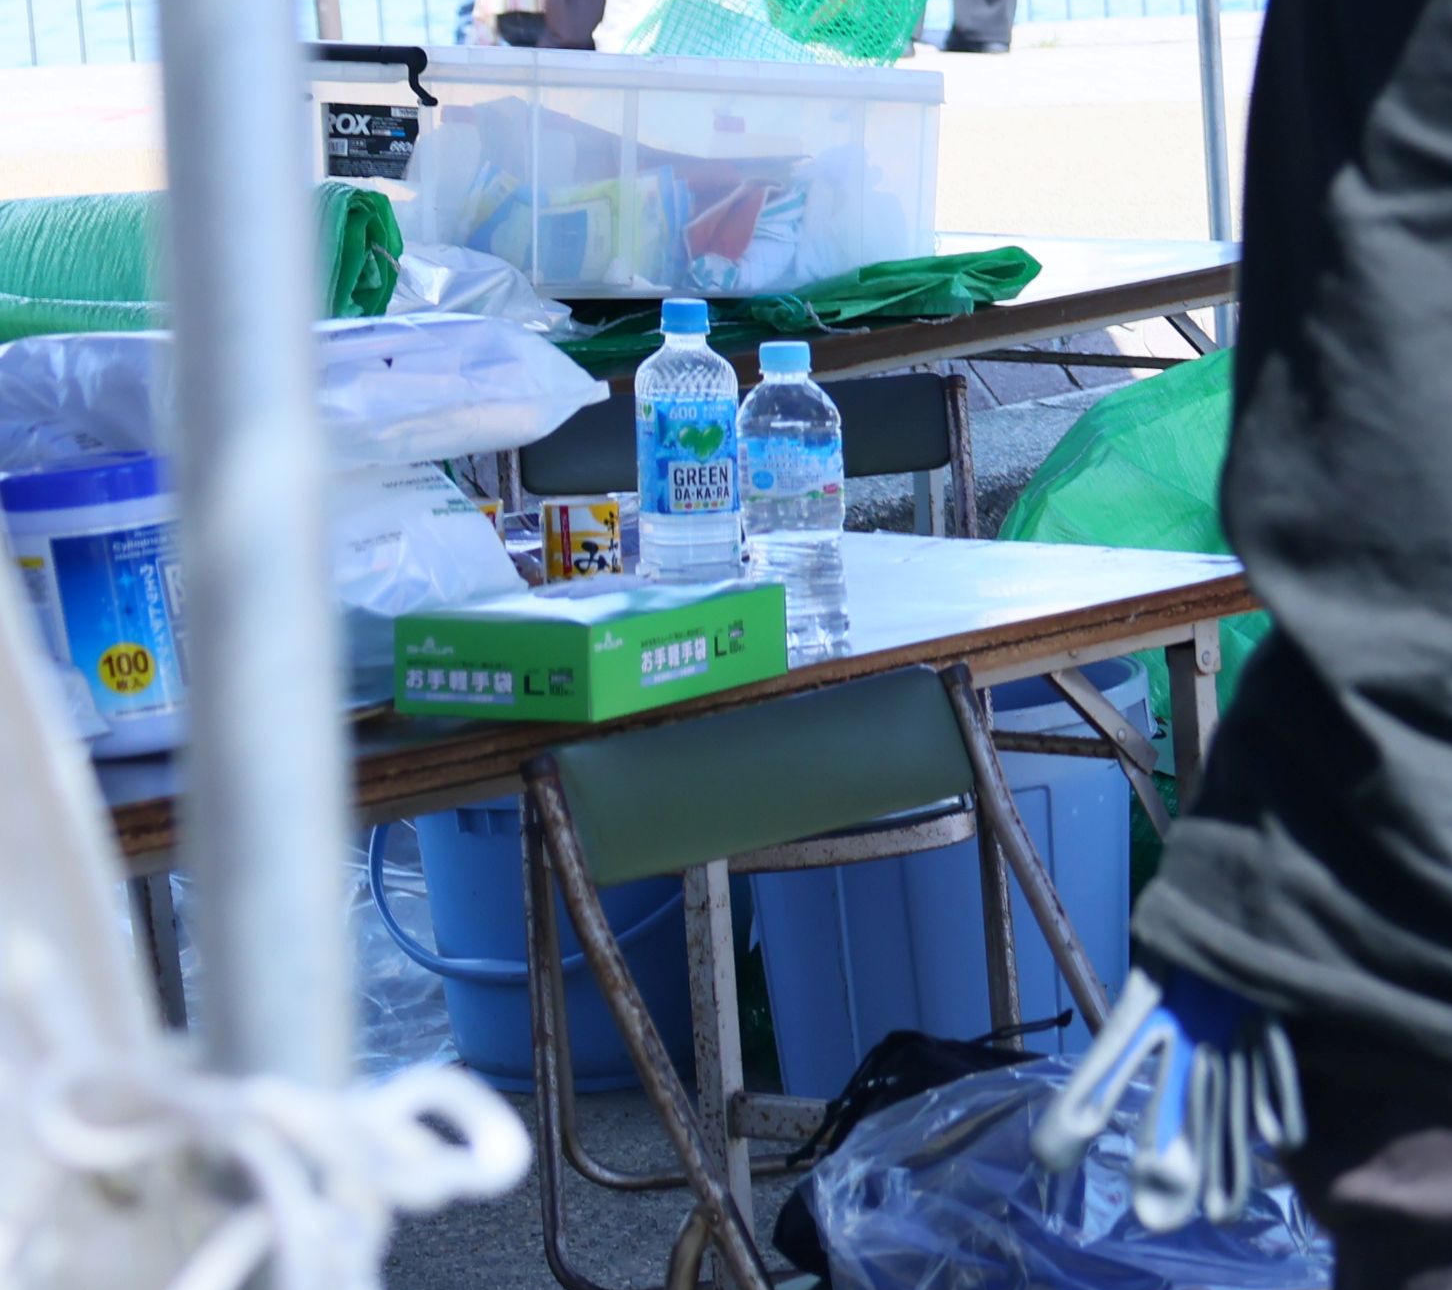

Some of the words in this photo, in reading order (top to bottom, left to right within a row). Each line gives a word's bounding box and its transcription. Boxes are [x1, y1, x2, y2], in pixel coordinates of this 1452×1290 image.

[673, 465, 729, 487] GREEN
[713, 635, 728, 658] L
[101, 649, 151, 679] 100
[523, 673, 545, 697] L
